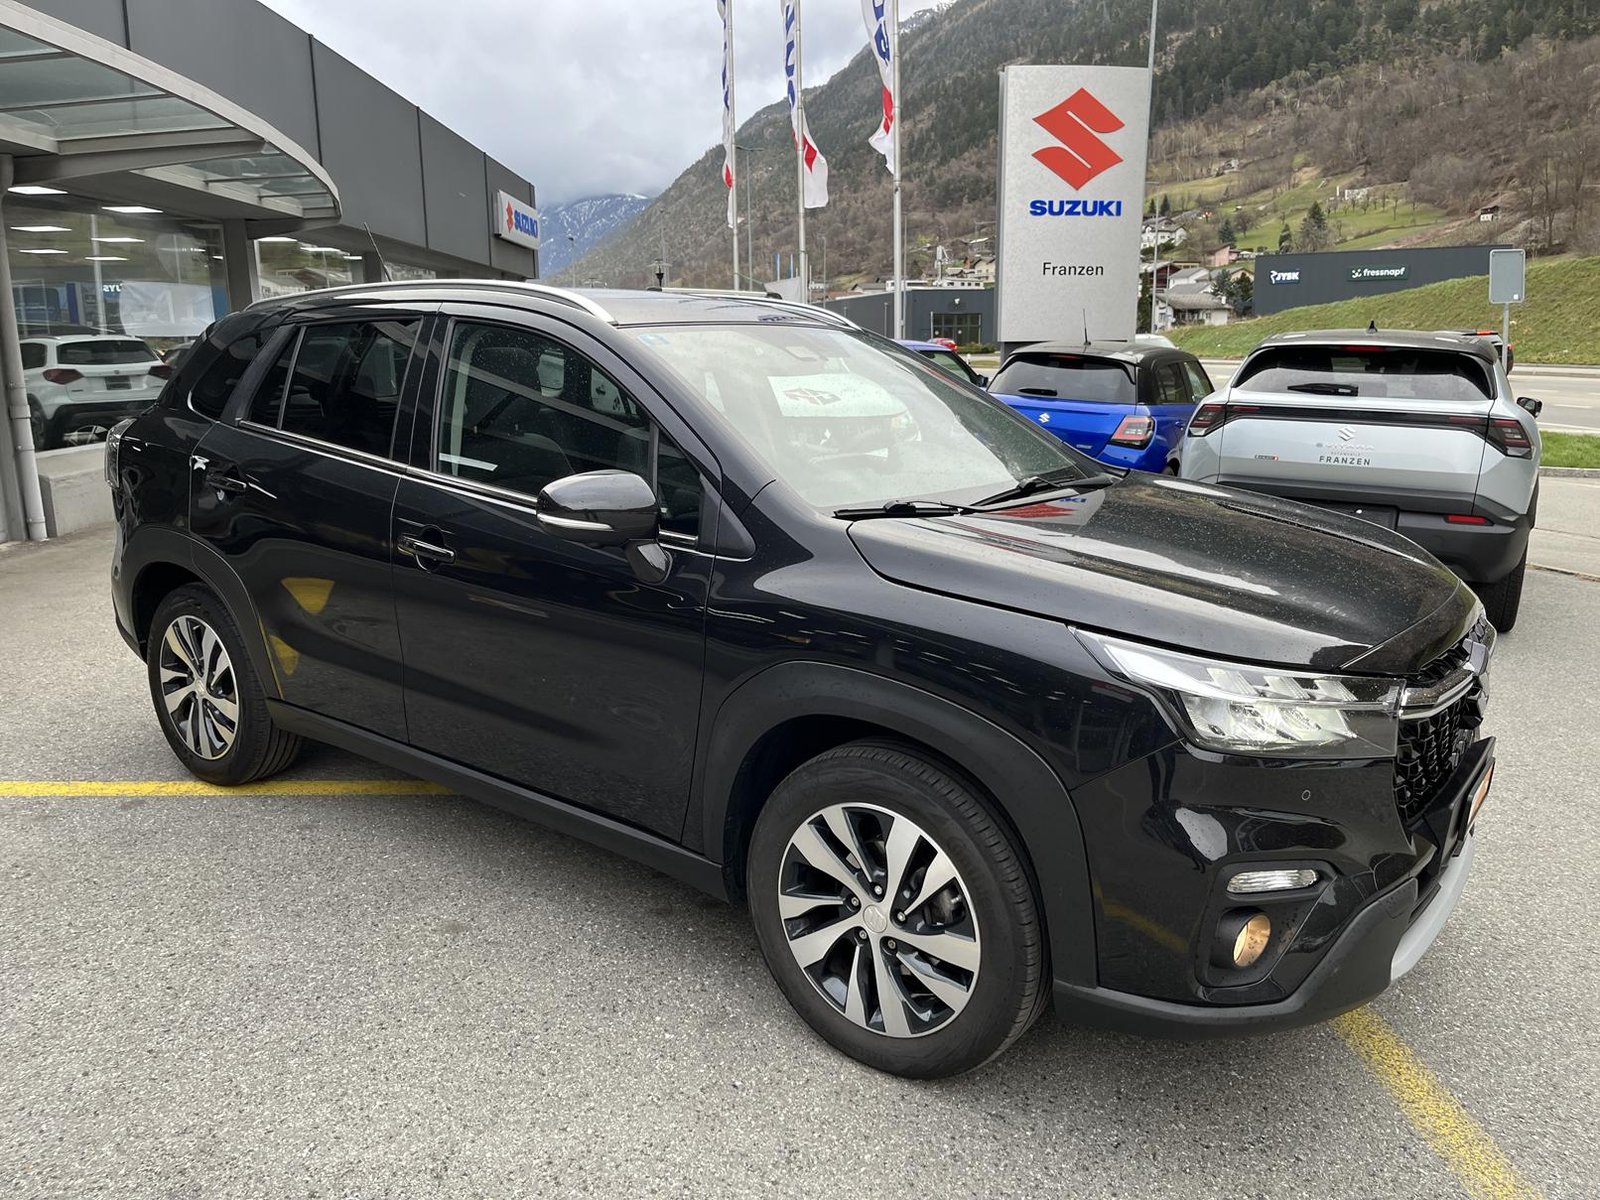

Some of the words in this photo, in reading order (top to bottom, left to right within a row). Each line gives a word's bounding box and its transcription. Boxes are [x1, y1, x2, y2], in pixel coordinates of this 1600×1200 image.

[1029, 200, 1122, 217] SUZUKI
[514, 210, 538, 238] SUZUKI
[1042, 262, 1104, 276] Franzen
[1363, 267, 1406, 278] fressnapf
[1276, 271, 1300, 281] JYSK
[1319, 455, 1371, 466] FRANZEN
